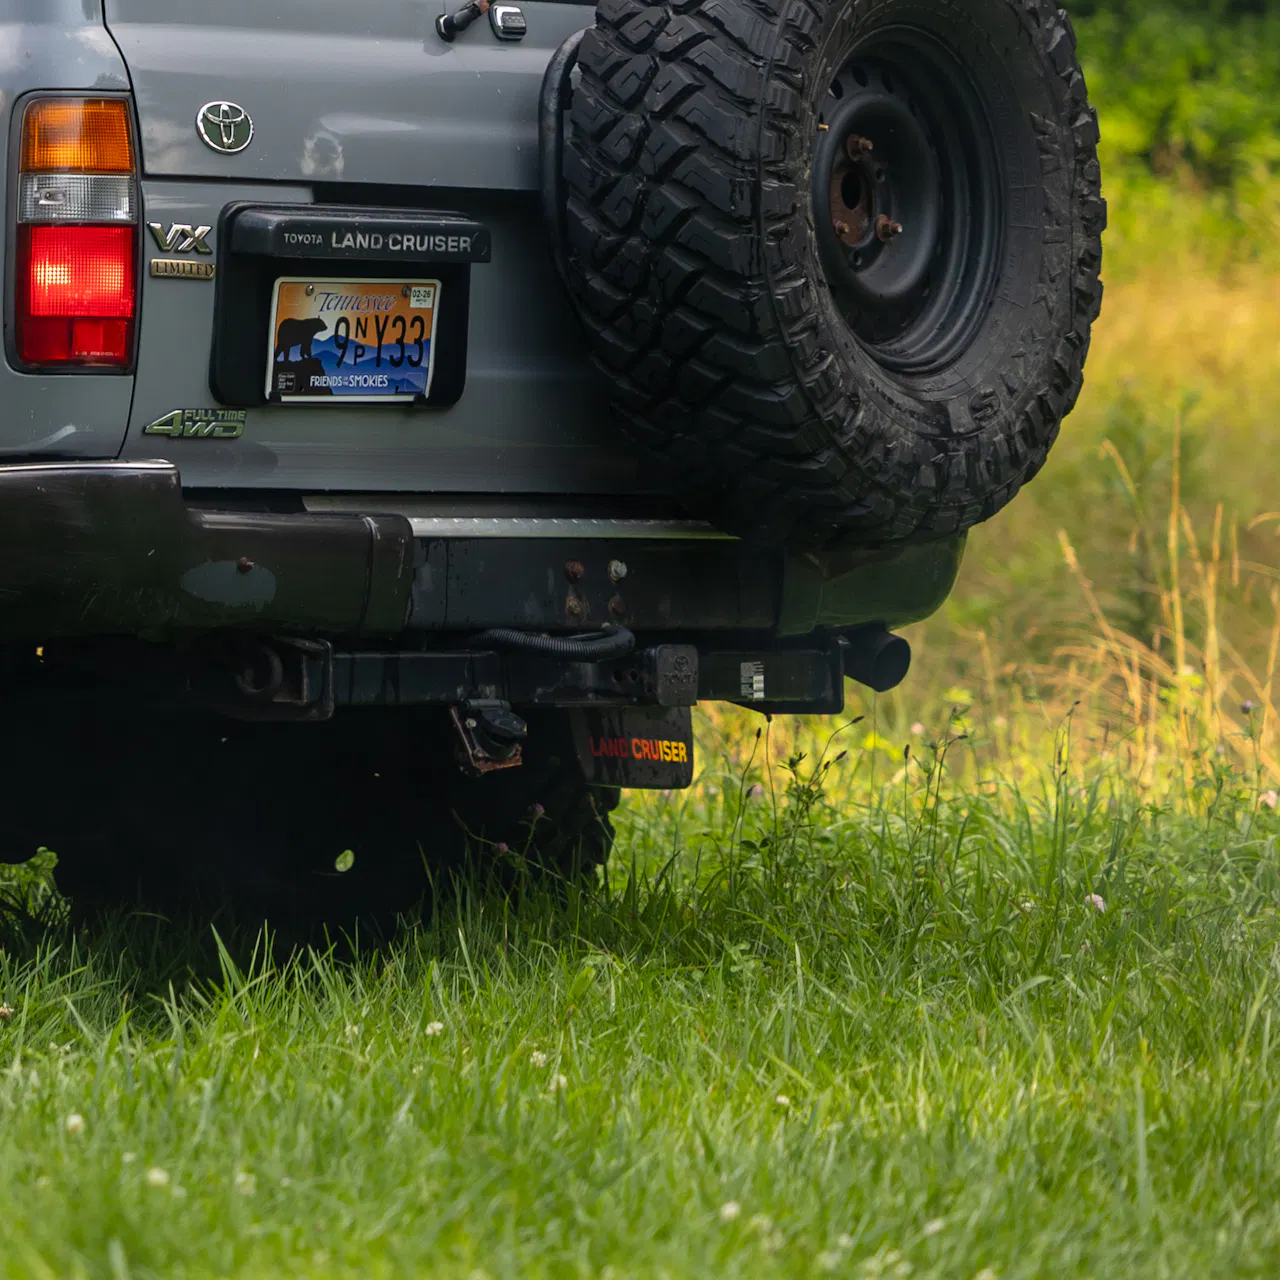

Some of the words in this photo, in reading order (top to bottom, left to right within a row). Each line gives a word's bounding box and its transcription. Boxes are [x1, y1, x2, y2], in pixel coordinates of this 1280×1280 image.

[146, 221, 213, 254] VX
[284, 233, 323, 245] TOYOTA
[331, 231, 383, 250] LAND
[388, 233, 471, 253] CRUISER
[153, 261, 214, 276] LIMITED
[313, 292, 398, 314] Tennessee
[309, 375, 342, 387] FRIENDS
[349, 375, 388, 387] SMOKIES
[144, 410, 244, 437] 4WD
[184, 410, 215, 420] FULL
[216, 410, 246, 420] TIME
[589, 735, 629, 758] LAND
[631, 738, 687, 762] CRUISER
